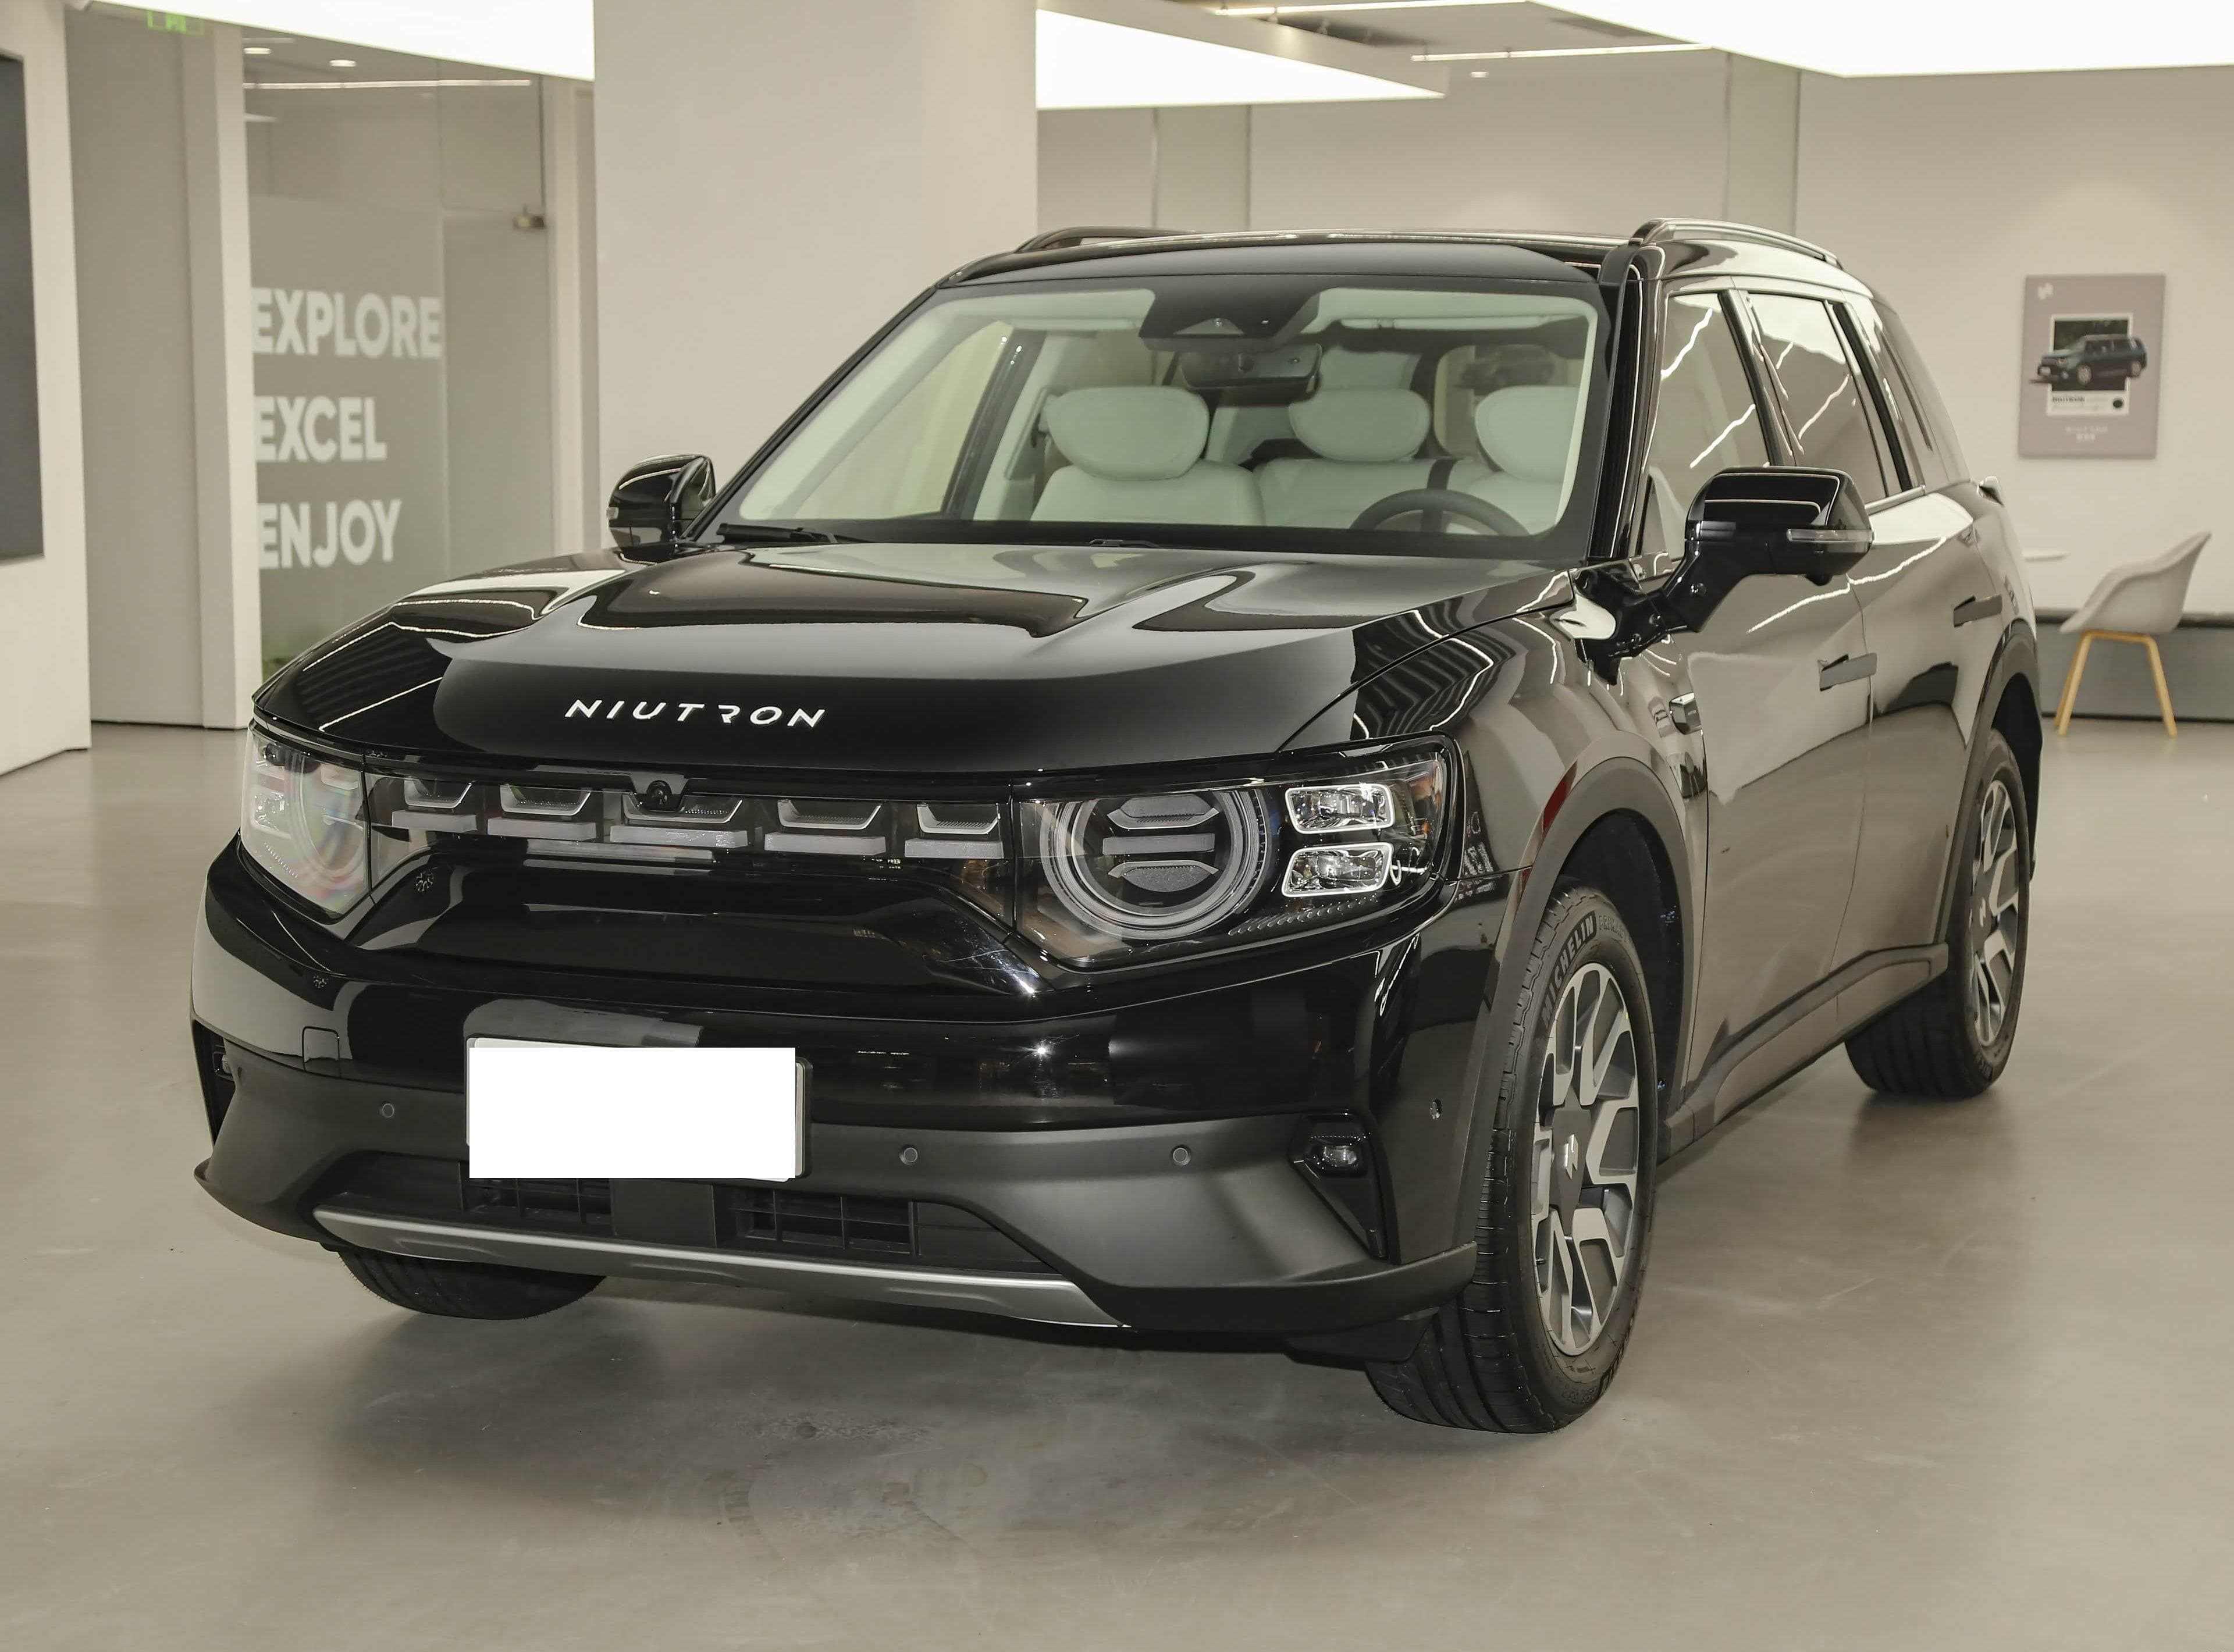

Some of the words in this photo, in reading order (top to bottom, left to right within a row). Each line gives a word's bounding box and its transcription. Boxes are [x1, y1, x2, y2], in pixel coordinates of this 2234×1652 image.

[251, 287, 443, 359] EXPLORE
[254, 396, 388, 463] EXCEL
[257, 498, 403, 569] ENJOY
[564, 699, 826, 728] NIUTRON
[1542, 915, 1595, 1030] MICHELIN
